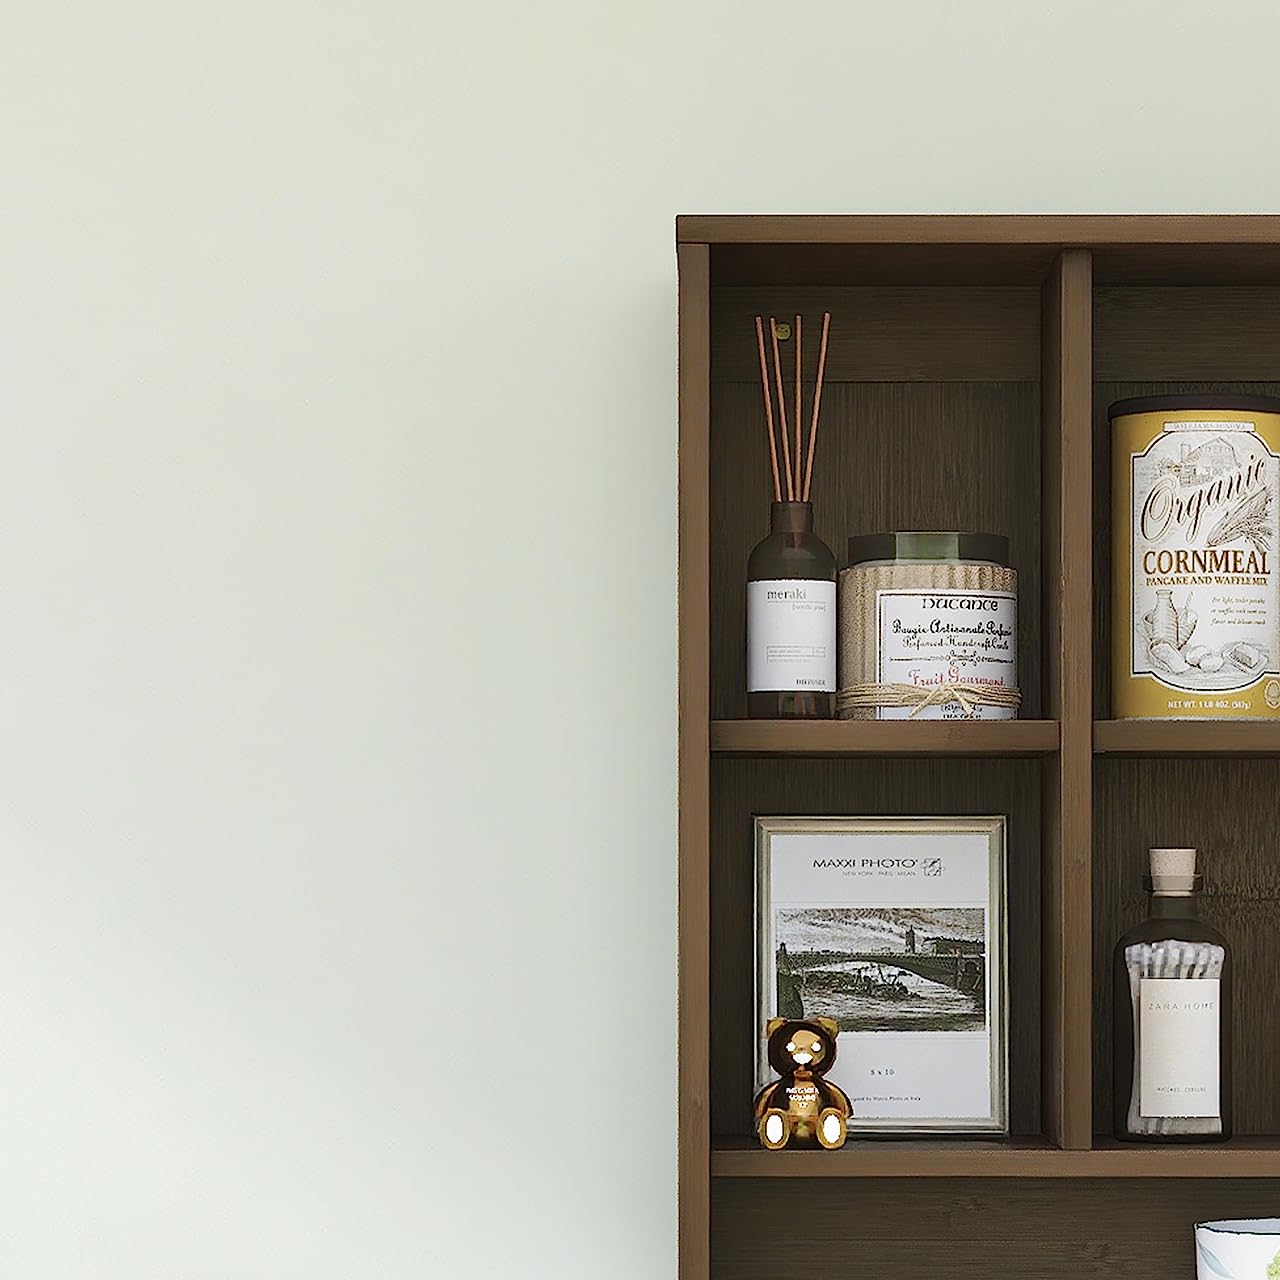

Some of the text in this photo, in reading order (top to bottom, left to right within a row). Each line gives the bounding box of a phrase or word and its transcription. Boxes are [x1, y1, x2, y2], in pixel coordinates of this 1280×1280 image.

[1140, 454, 1267, 544] Organic
[1143, 550, 1271, 574] CORNMEAL
[1146, 577, 1268, 586] PANCAKE AND WAFFLE MIX
[767, 588, 807, 600] meraki
[908, 668, 946, 686] Fruit
[813, 859, 856, 868] MAXXI
[1149, 1002, 1215, 1010] ZARA HOME
